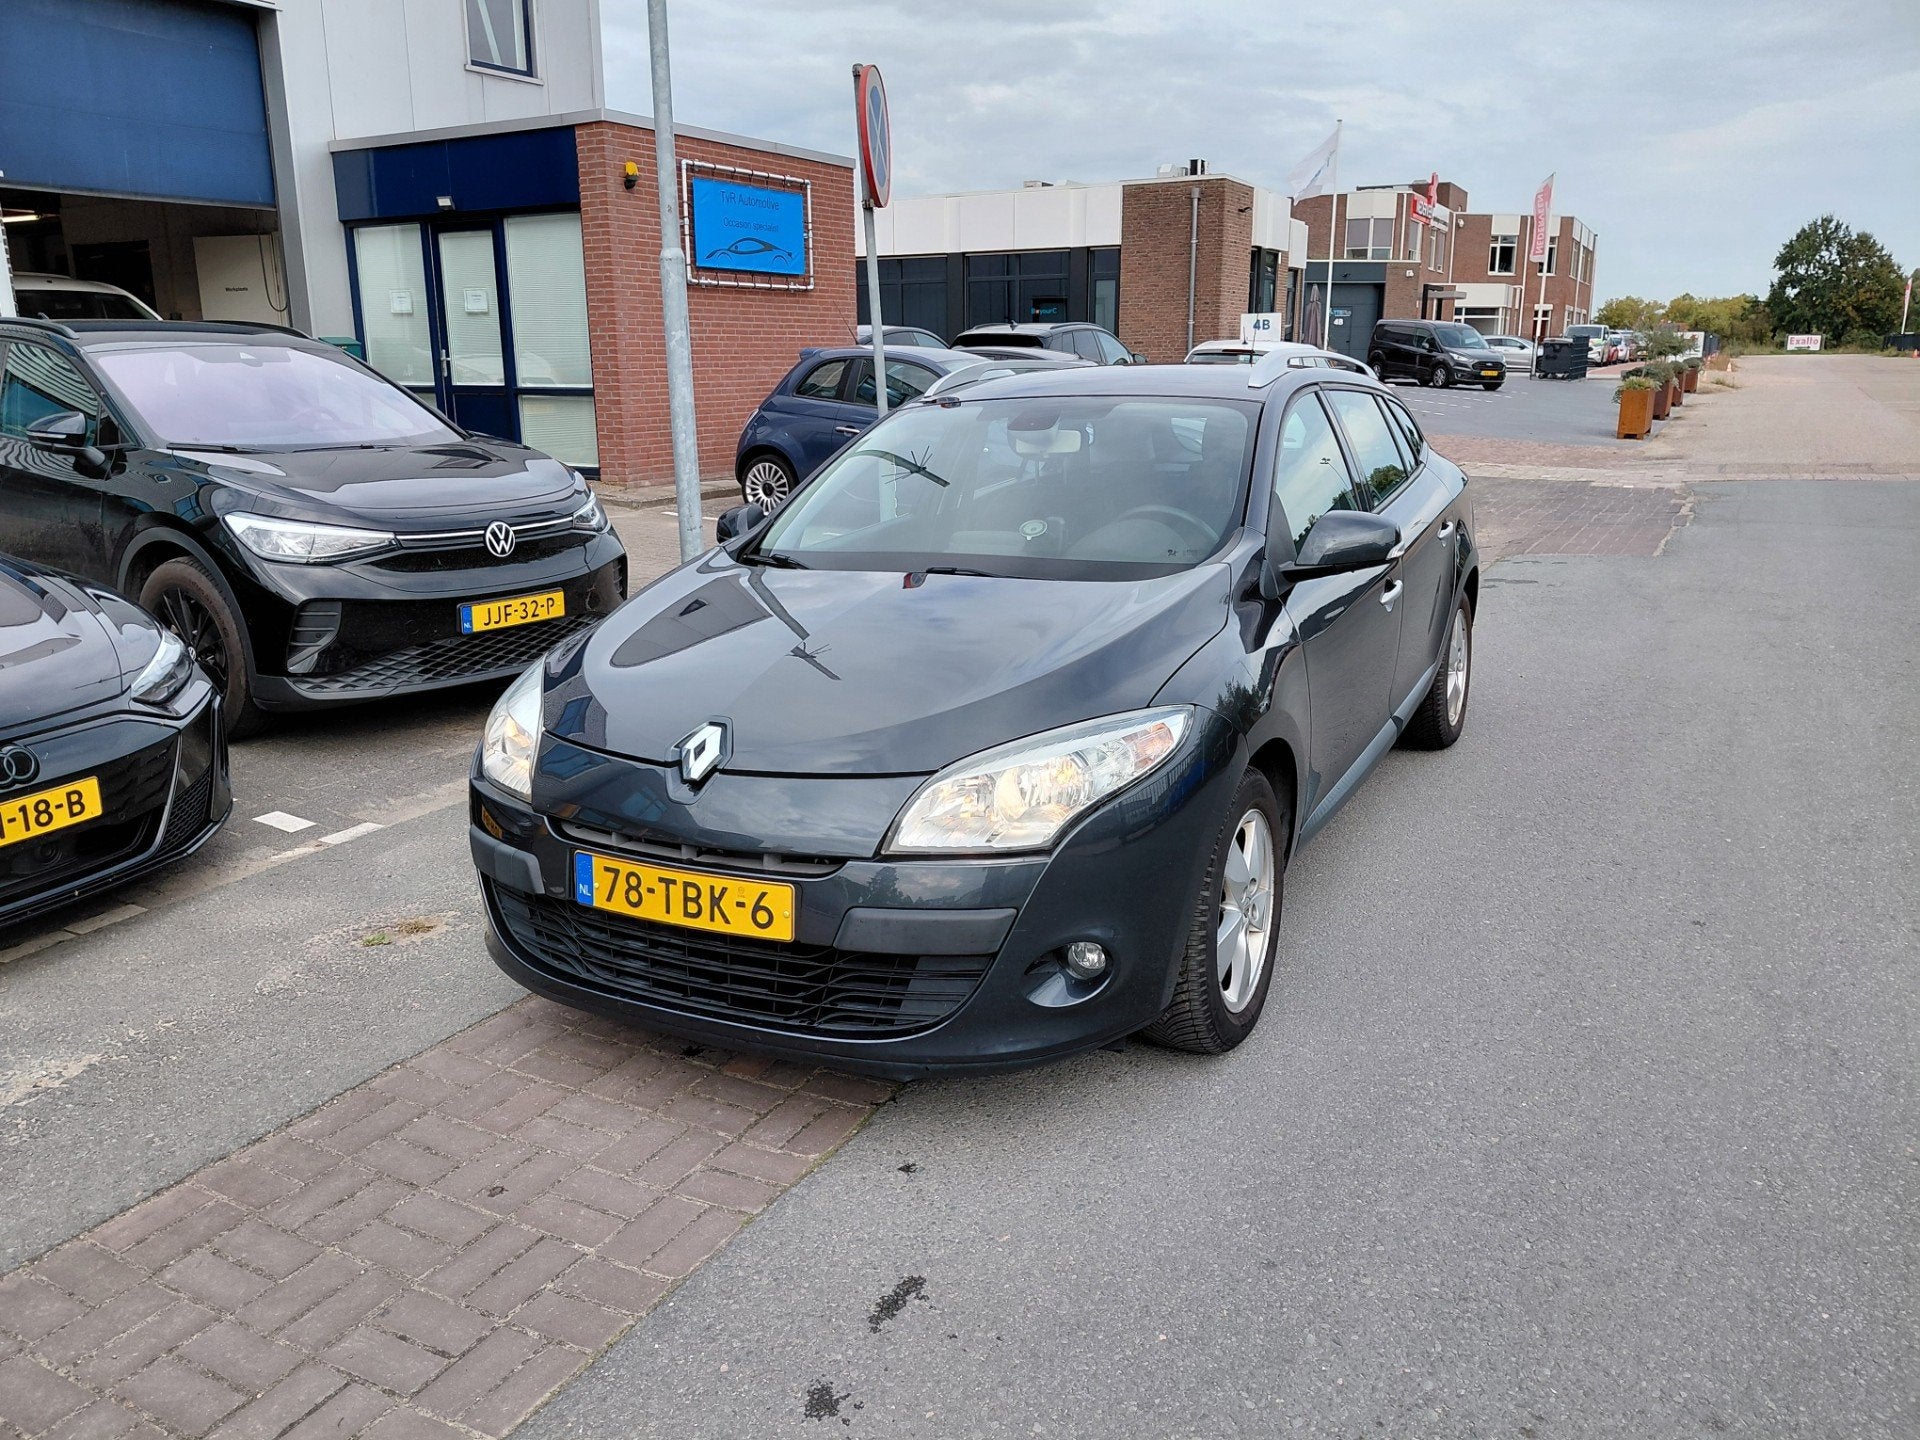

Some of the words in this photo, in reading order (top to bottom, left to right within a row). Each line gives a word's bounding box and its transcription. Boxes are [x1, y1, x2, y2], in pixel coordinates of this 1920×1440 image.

[720, 190, 737, 204] TvR
[739, 194, 780, 211] Automotive
[724, 217, 752, 230] Occasion
[753, 221, 779, 232] specialist
[1253, 319, 1271, 331] 4B
[483, 597, 555, 627] JJF-32-P
[0, 789, 86, 840] -18-B
[579, 883, 592, 897] NL
[603, 865, 774, 930] 78-TBK-6
